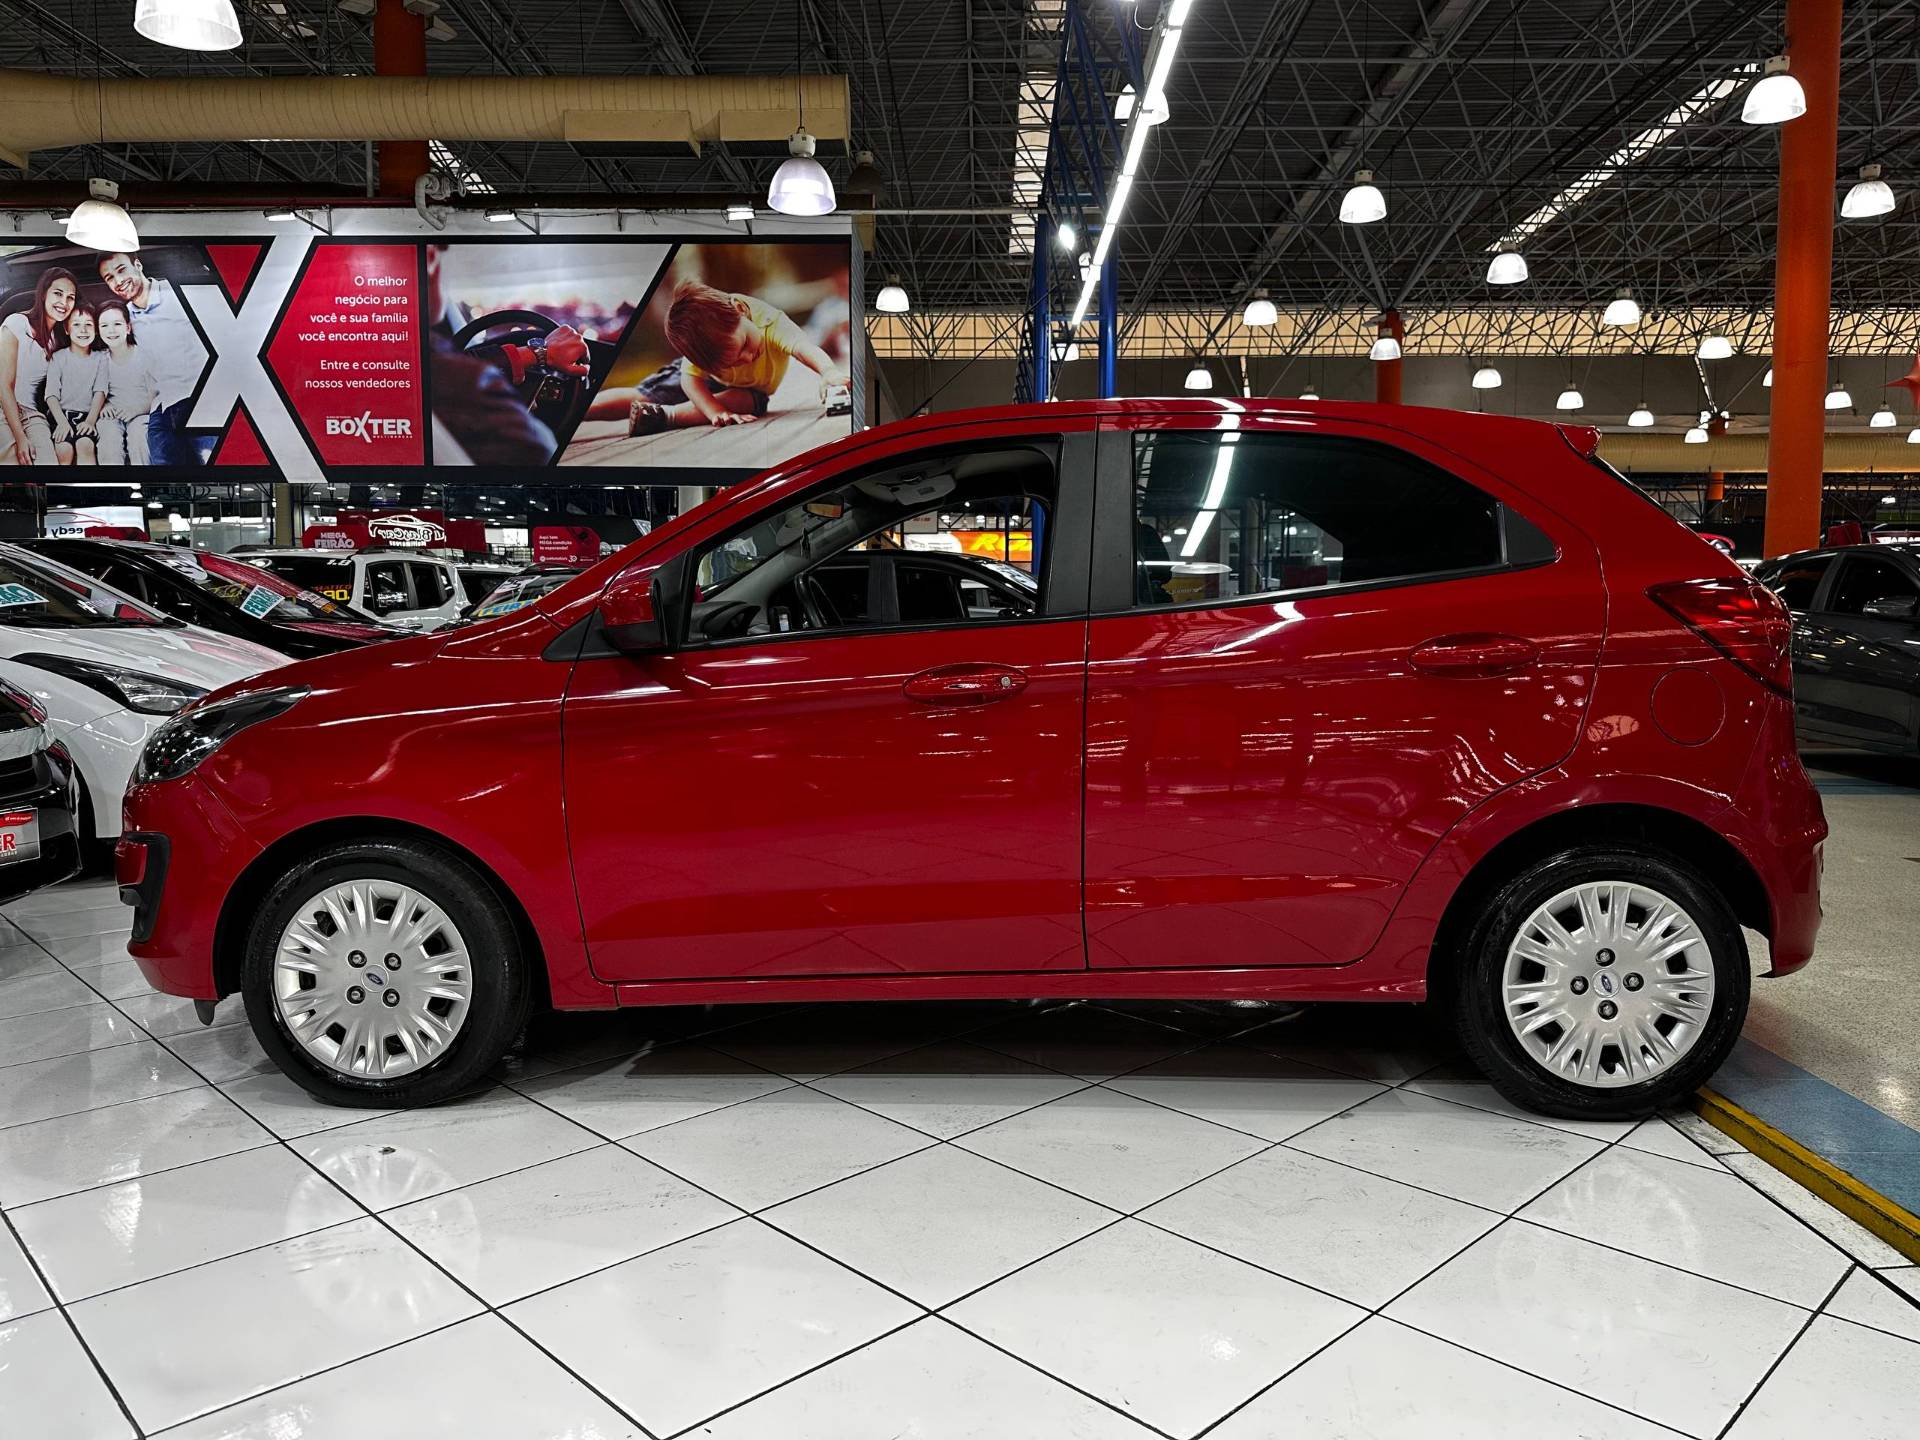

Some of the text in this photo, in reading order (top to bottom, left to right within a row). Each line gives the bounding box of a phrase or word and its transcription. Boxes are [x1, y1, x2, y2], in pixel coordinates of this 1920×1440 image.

[354, 275, 408, 287] O melhor
[335, 293, 408, 307] negócio para
[310, 312, 409, 323] você e sua família
[299, 330, 409, 343] você encontra aqui!
[320, 359, 411, 370] Entre e consulte
[305, 378, 411, 388] nossos vendedores
[326, 411, 412, 443] BOXTER
[315, 538, 355, 549] FEIRÃO
